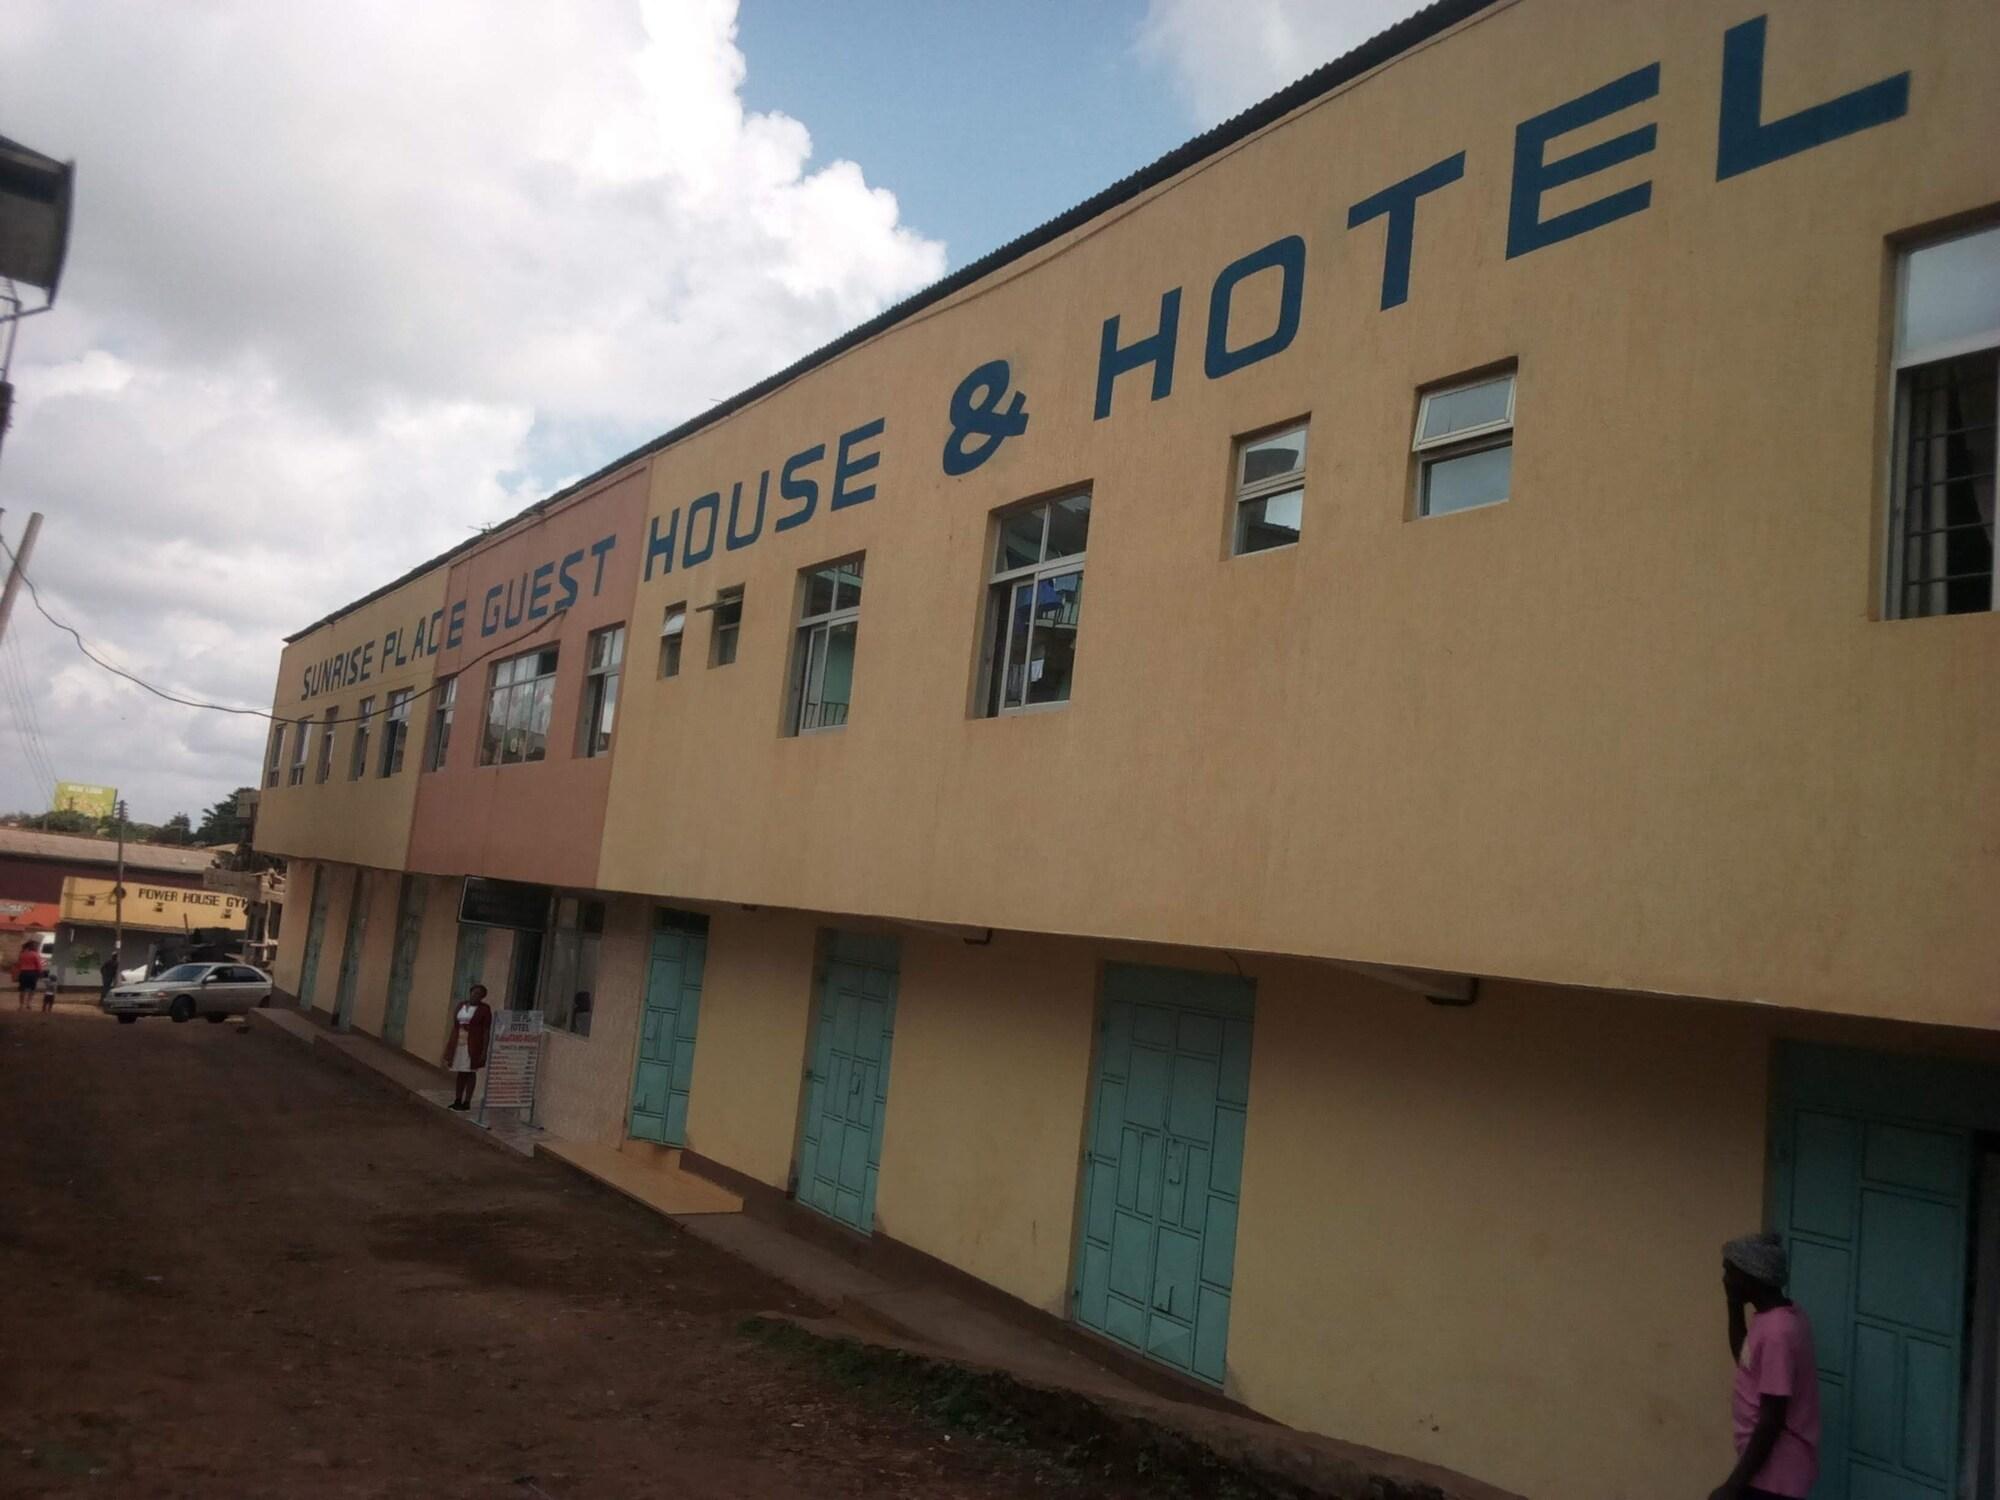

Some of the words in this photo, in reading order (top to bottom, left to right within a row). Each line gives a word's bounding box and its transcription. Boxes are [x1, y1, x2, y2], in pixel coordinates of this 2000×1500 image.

[301, 641, 375, 700] SUNRISE
[381, 600, 466, 672] PLACE
[481, 535, 617, 637] GUEST
[644, 417, 886, 581] HOUSE
[943, 359, 1029, 476] &
[1094, 14, 1911, 420] HOTEL
[138, 888, 178, 902] POWER
[183, 892, 220, 906] HOUSE
